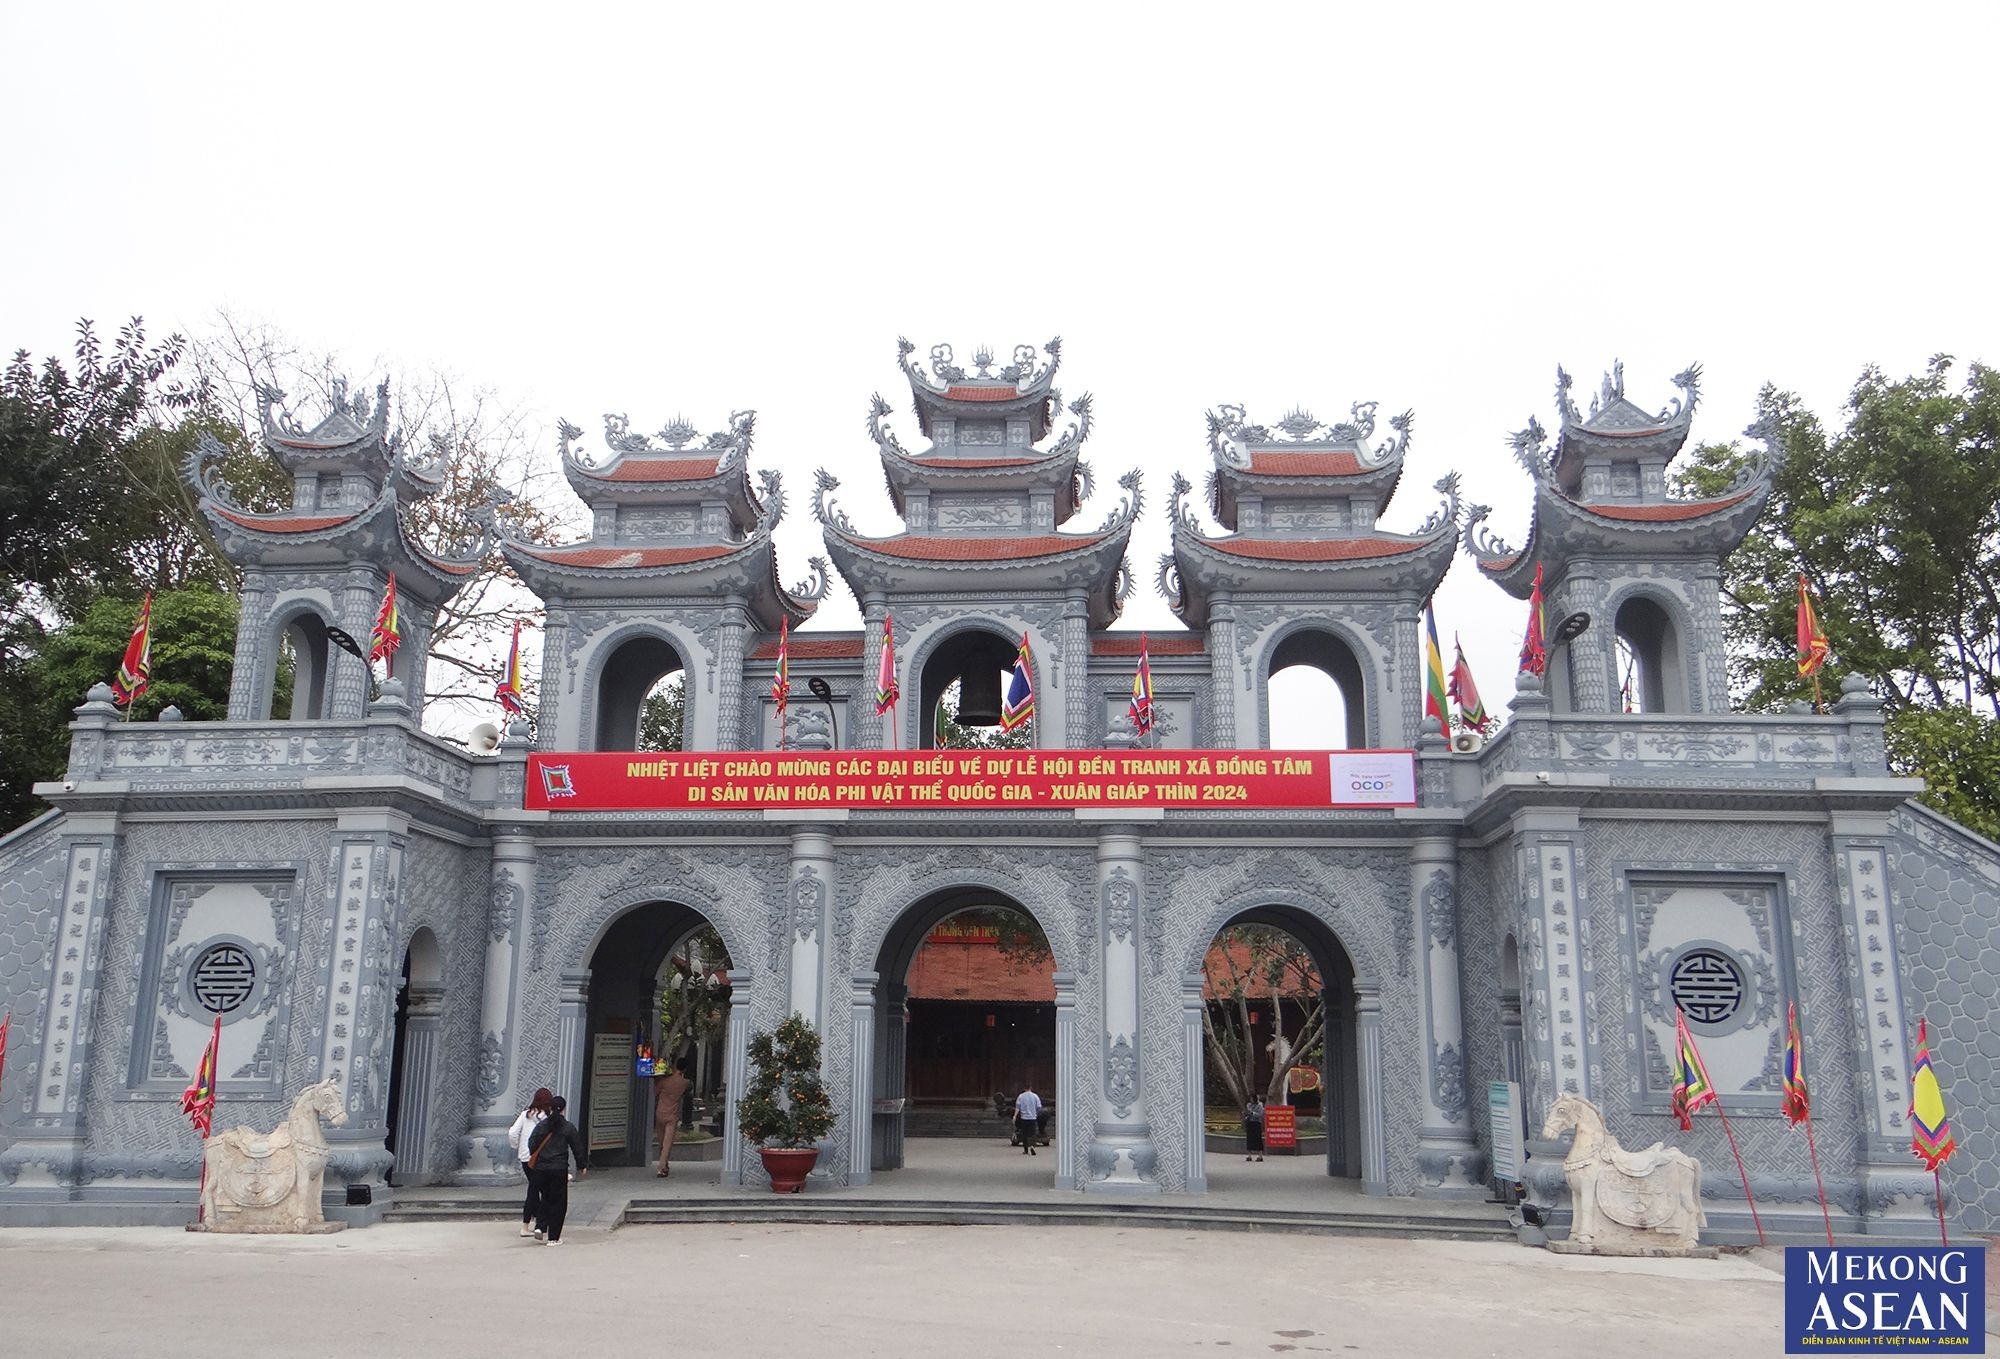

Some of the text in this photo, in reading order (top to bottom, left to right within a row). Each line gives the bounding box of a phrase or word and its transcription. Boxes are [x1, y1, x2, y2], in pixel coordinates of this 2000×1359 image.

[627, 755, 1312, 780] NHIỆT LIỆT CHÀO MỪNG CÁC ĐẠI BIỂU VỀ DỰ LỄ HỘI ĐỀN TRANH XÃ ĐỒNG TÂM
[688, 787, 706, 801] DI
[711, 782, 748, 801] SẢN
[754, 783, 789, 801] VĂN
[795, 783, 830, 801] HÓA
[836, 786, 865, 801] PHI
[871, 783, 904, 803] VẬT
[909, 780, 943, 800] THỂ
[948, 780, 996, 801] QUỐC
[1002, 785, 1032, 800] GIA
[1051, 782, 1101, 800] XUÂN
[1106, 781, 1149, 800] GIÁP
[1155, 782, 1197, 800] THÌN
[1203, 785, 1247, 800] 2024
[1351, 780, 1393, 790] OCOP
